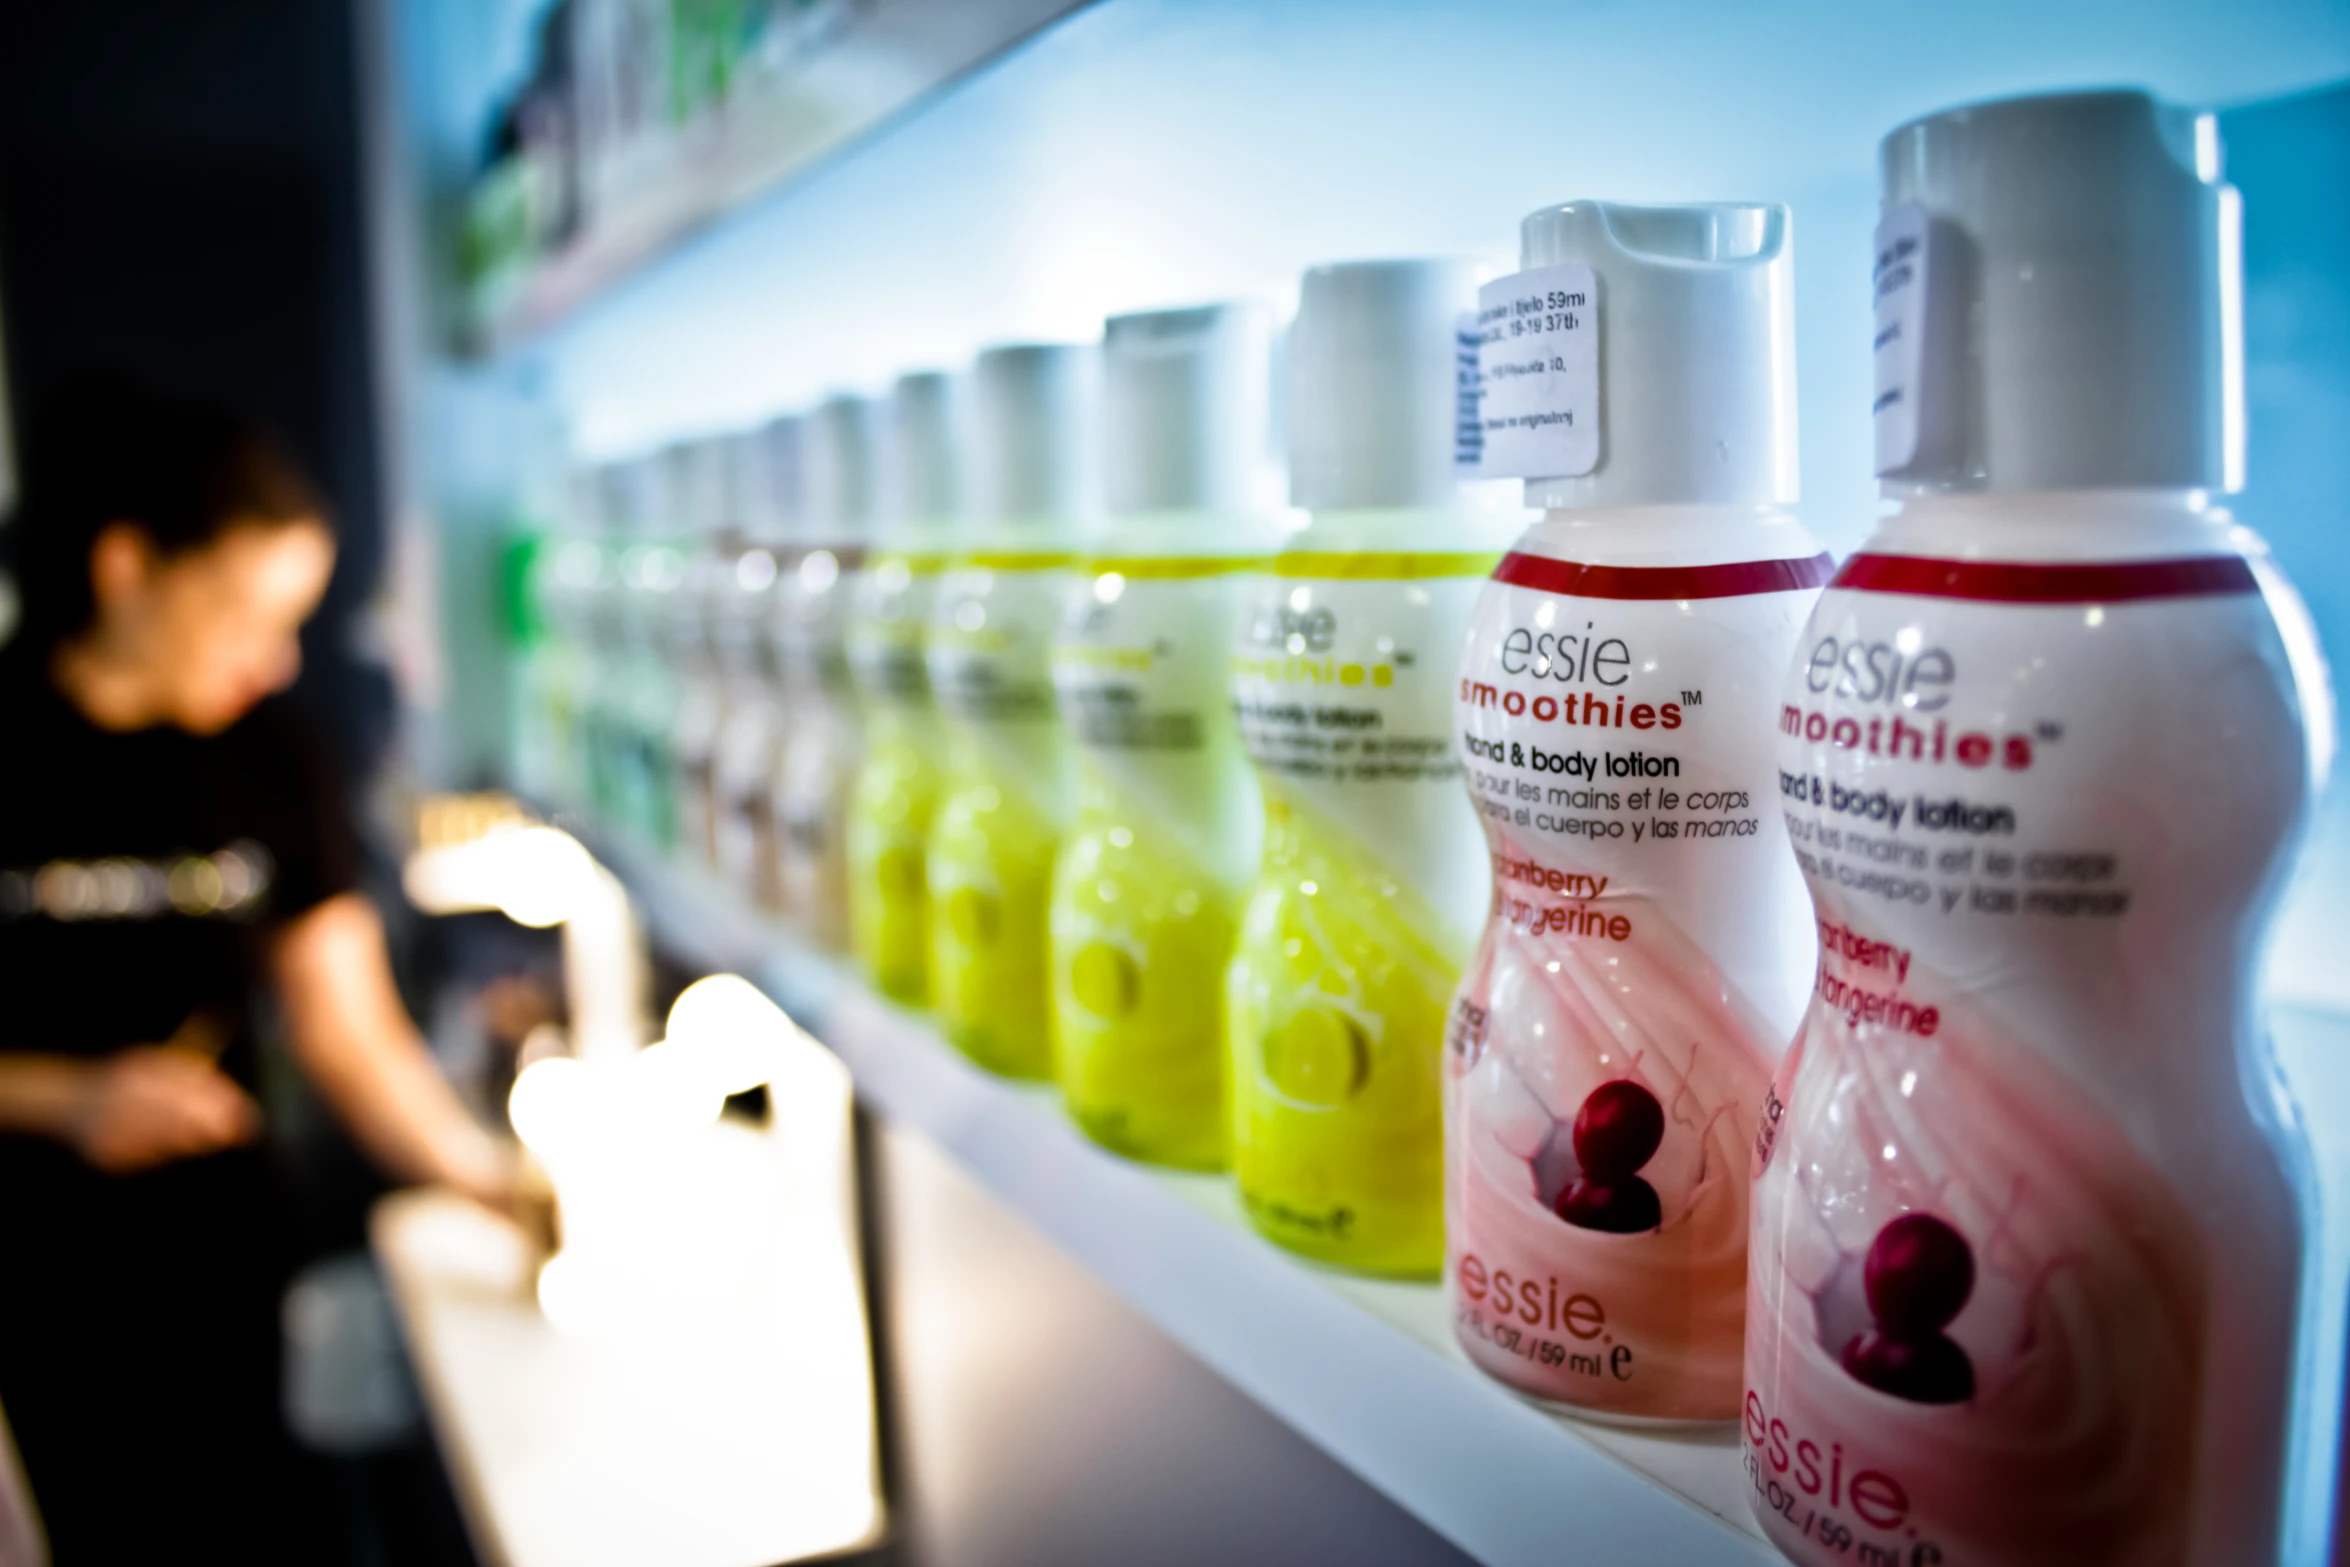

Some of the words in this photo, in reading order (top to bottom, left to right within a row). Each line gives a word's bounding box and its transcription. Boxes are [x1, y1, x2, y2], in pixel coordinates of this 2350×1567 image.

[1501, 622, 1631, 686] essie
[1805, 636, 1957, 712] essie
[1460, 677, 1682, 730] smoothies
[1511, 742, 1525, 768] &
[1532, 745, 1597, 782] body
[1605, 751, 1680, 778] lotion
[1780, 704, 2035, 772] moothies
[1515, 777, 1541, 803] les
[1548, 787, 1621, 812] mains
[1627, 786, 1654, 812] et
[1657, 787, 1682, 812] le
[1686, 789, 1750, 816] corps
[1779, 770, 1807, 803] and
[1830, 778, 1907, 831] body
[1914, 795, 2017, 838] lotion
[1536, 812, 1624, 842] cuerpo
[1632, 819, 1647, 843] y
[1650, 815, 1679, 838] las
[1684, 816, 1760, 839] manos
[1821, 920, 1911, 985] anberry
[1540, 1341, 1566, 1368] 59
[1570, 1353, 1601, 1378] ml
